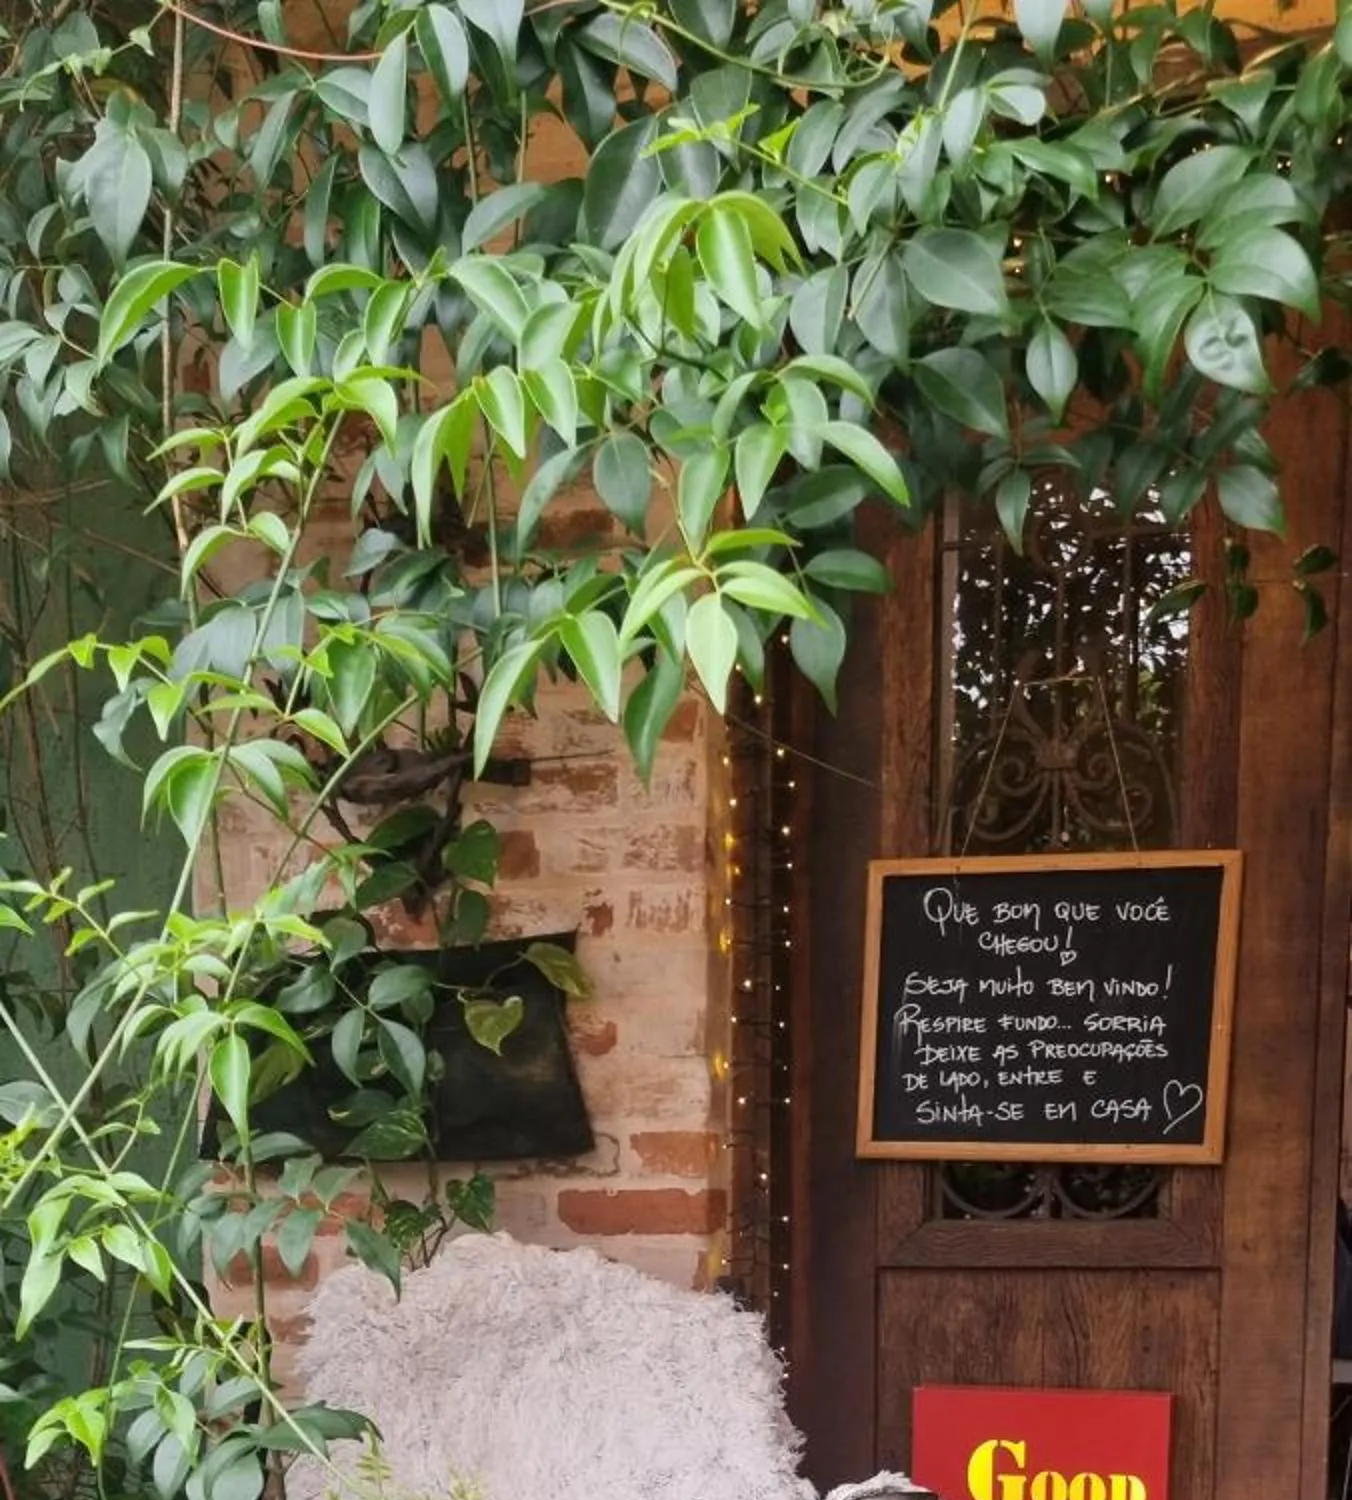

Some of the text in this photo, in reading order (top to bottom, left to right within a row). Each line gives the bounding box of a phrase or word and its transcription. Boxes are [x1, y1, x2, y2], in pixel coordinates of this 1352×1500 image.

[923, 887, 1171, 937] QUE BOM QUE VOCÊ
[978, 925, 1073, 957] CHEGOU!
[904, 964, 1173, 1004] SEJA MUITO BEM VINDO!
[894, 1003, 987, 1047] RESPIRE
[1083, 1013, 1167, 1037] SORRIA
[913, 1039, 1169, 1067] DEIXE AS PREOCUPAÇÕES
[901, 1064, 1098, 1094] DE LADO, ENTRE E
[916, 1093, 1152, 1127] SINTA-SE EM CASA
